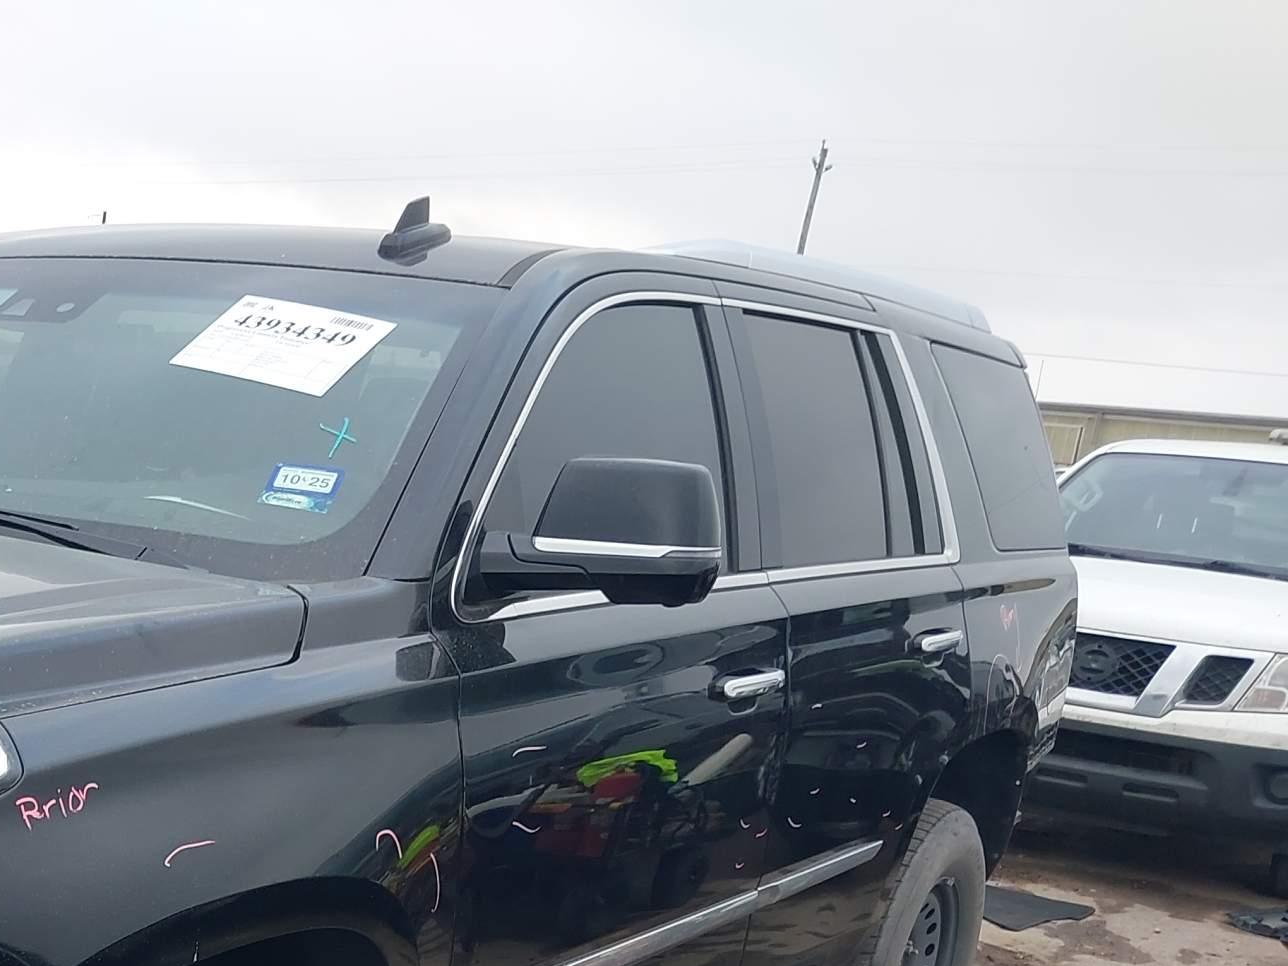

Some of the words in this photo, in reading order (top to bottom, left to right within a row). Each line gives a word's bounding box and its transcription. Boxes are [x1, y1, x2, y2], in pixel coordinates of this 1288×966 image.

[234, 314, 356, 346] 43934349
[282, 473, 301, 486] 10
[308, 476, 331, 489] 25
